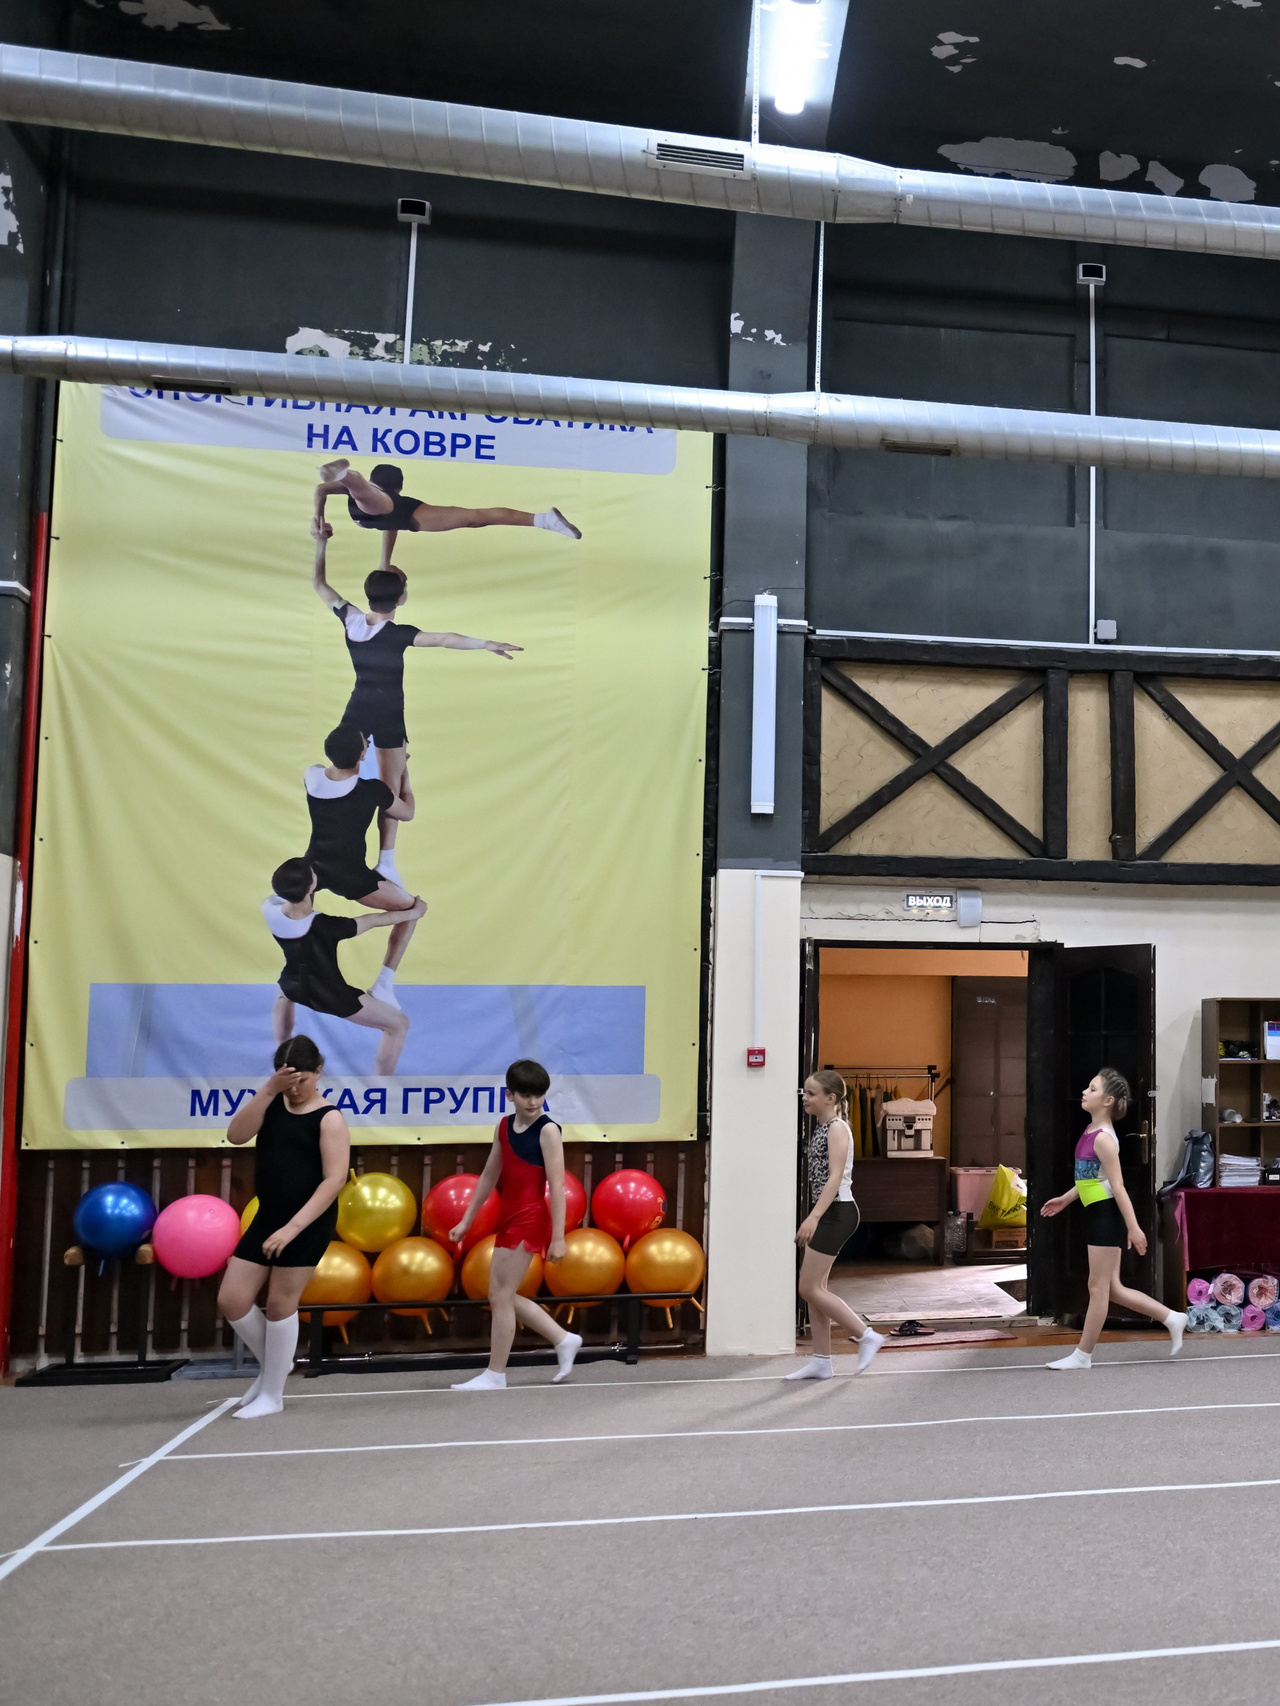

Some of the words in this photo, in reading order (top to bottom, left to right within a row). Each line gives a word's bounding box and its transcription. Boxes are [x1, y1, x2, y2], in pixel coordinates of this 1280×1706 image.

[306, 423, 359, 451] НА
[371, 427, 496, 460] КОВРЕ
[908, 896, 951, 907] ВЫХОД
[190, 1088, 387, 1117] МУАЯ
[402, 1087, 550, 1114] ГРУП
